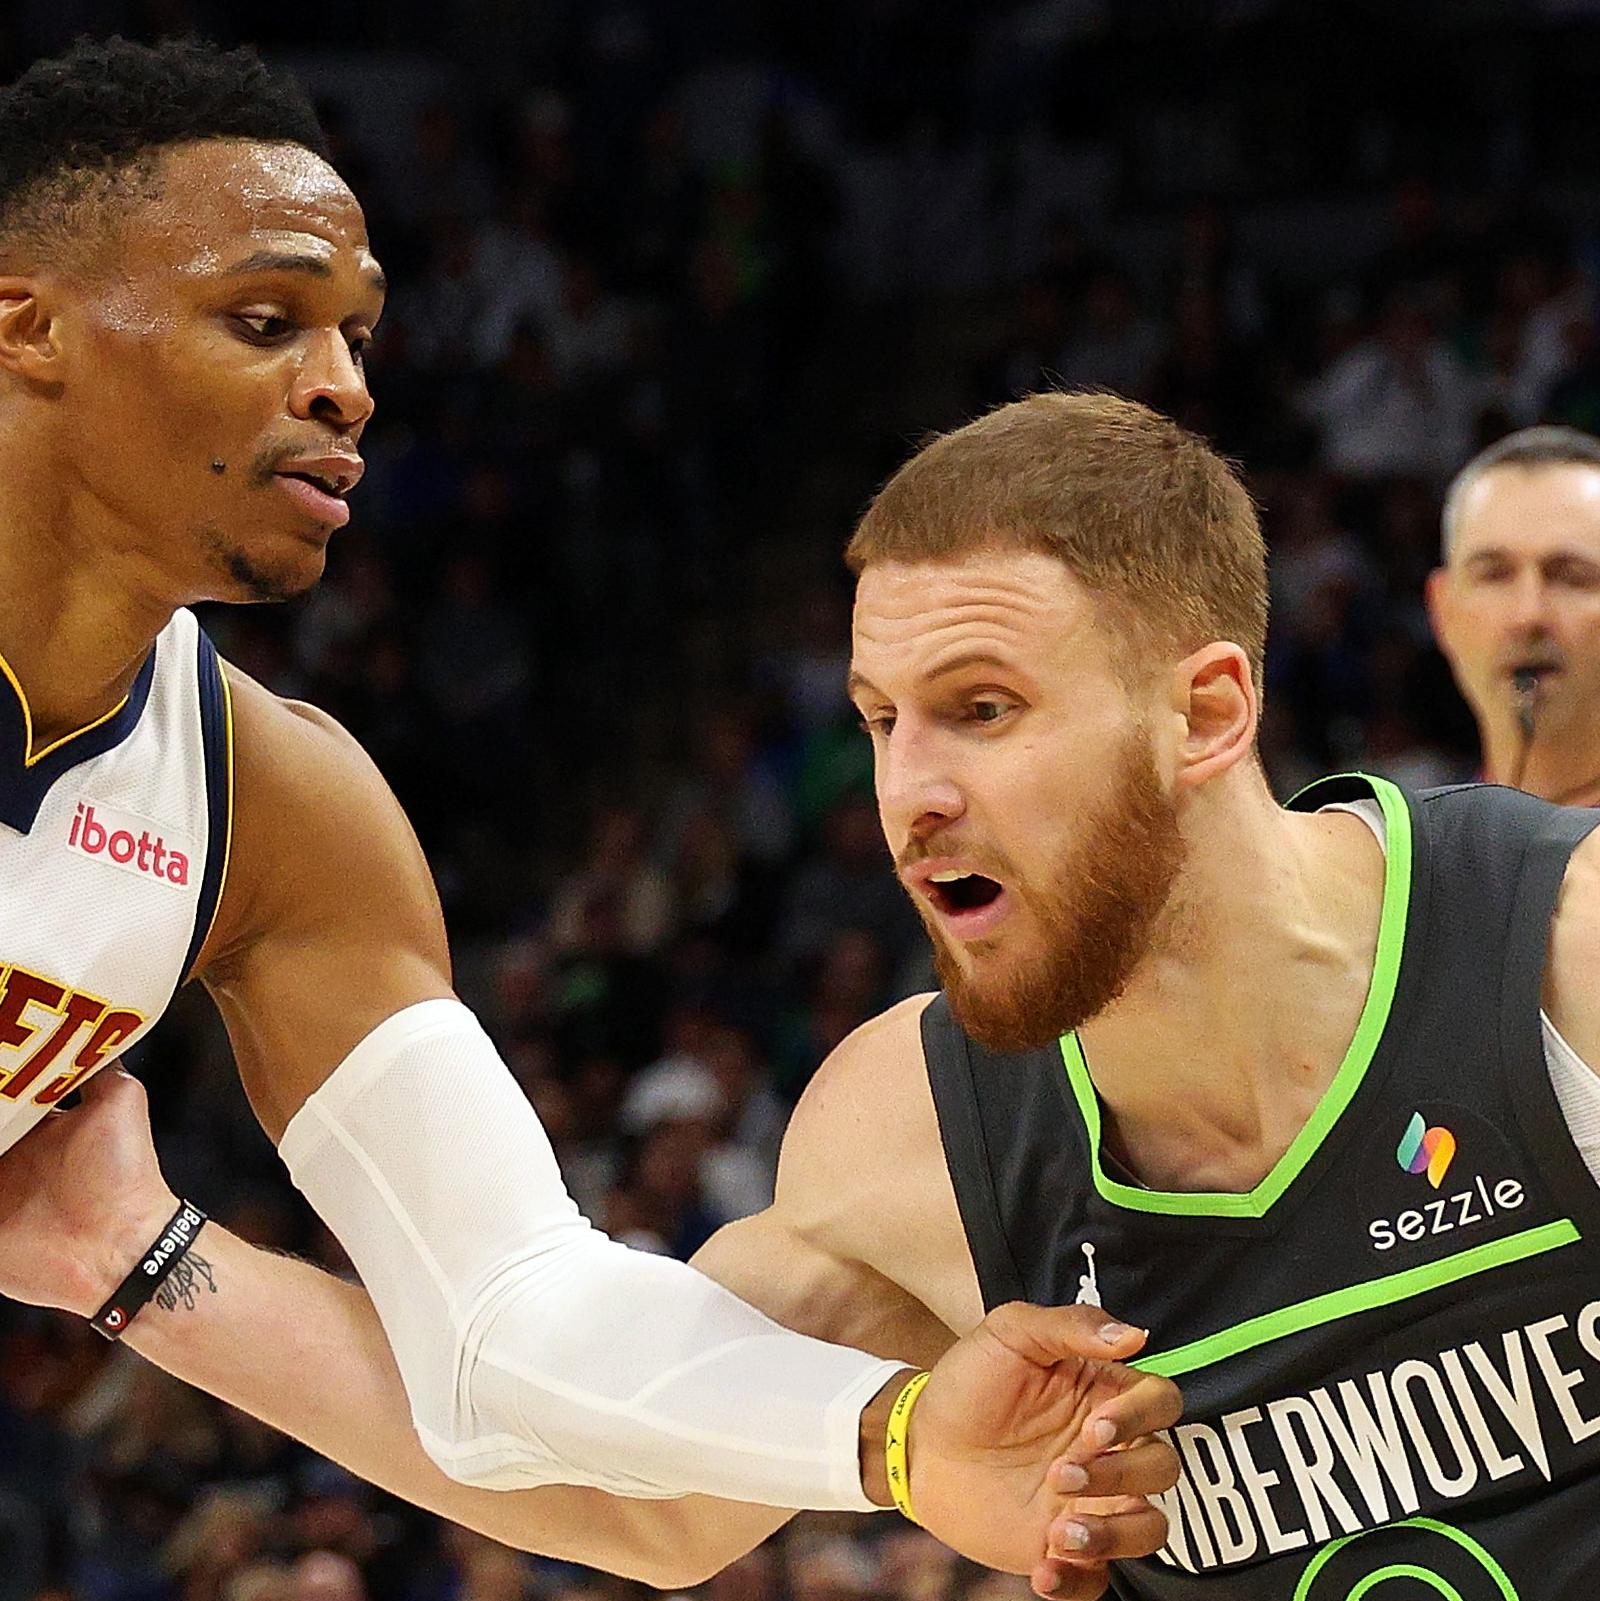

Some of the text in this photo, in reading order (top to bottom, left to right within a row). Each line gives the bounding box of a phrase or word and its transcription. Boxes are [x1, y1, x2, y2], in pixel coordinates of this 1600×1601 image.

[68, 802, 190, 886] ibotta
[143, 1207, 201, 1276] Believe
[1368, 1174, 1525, 1250] sezzle
